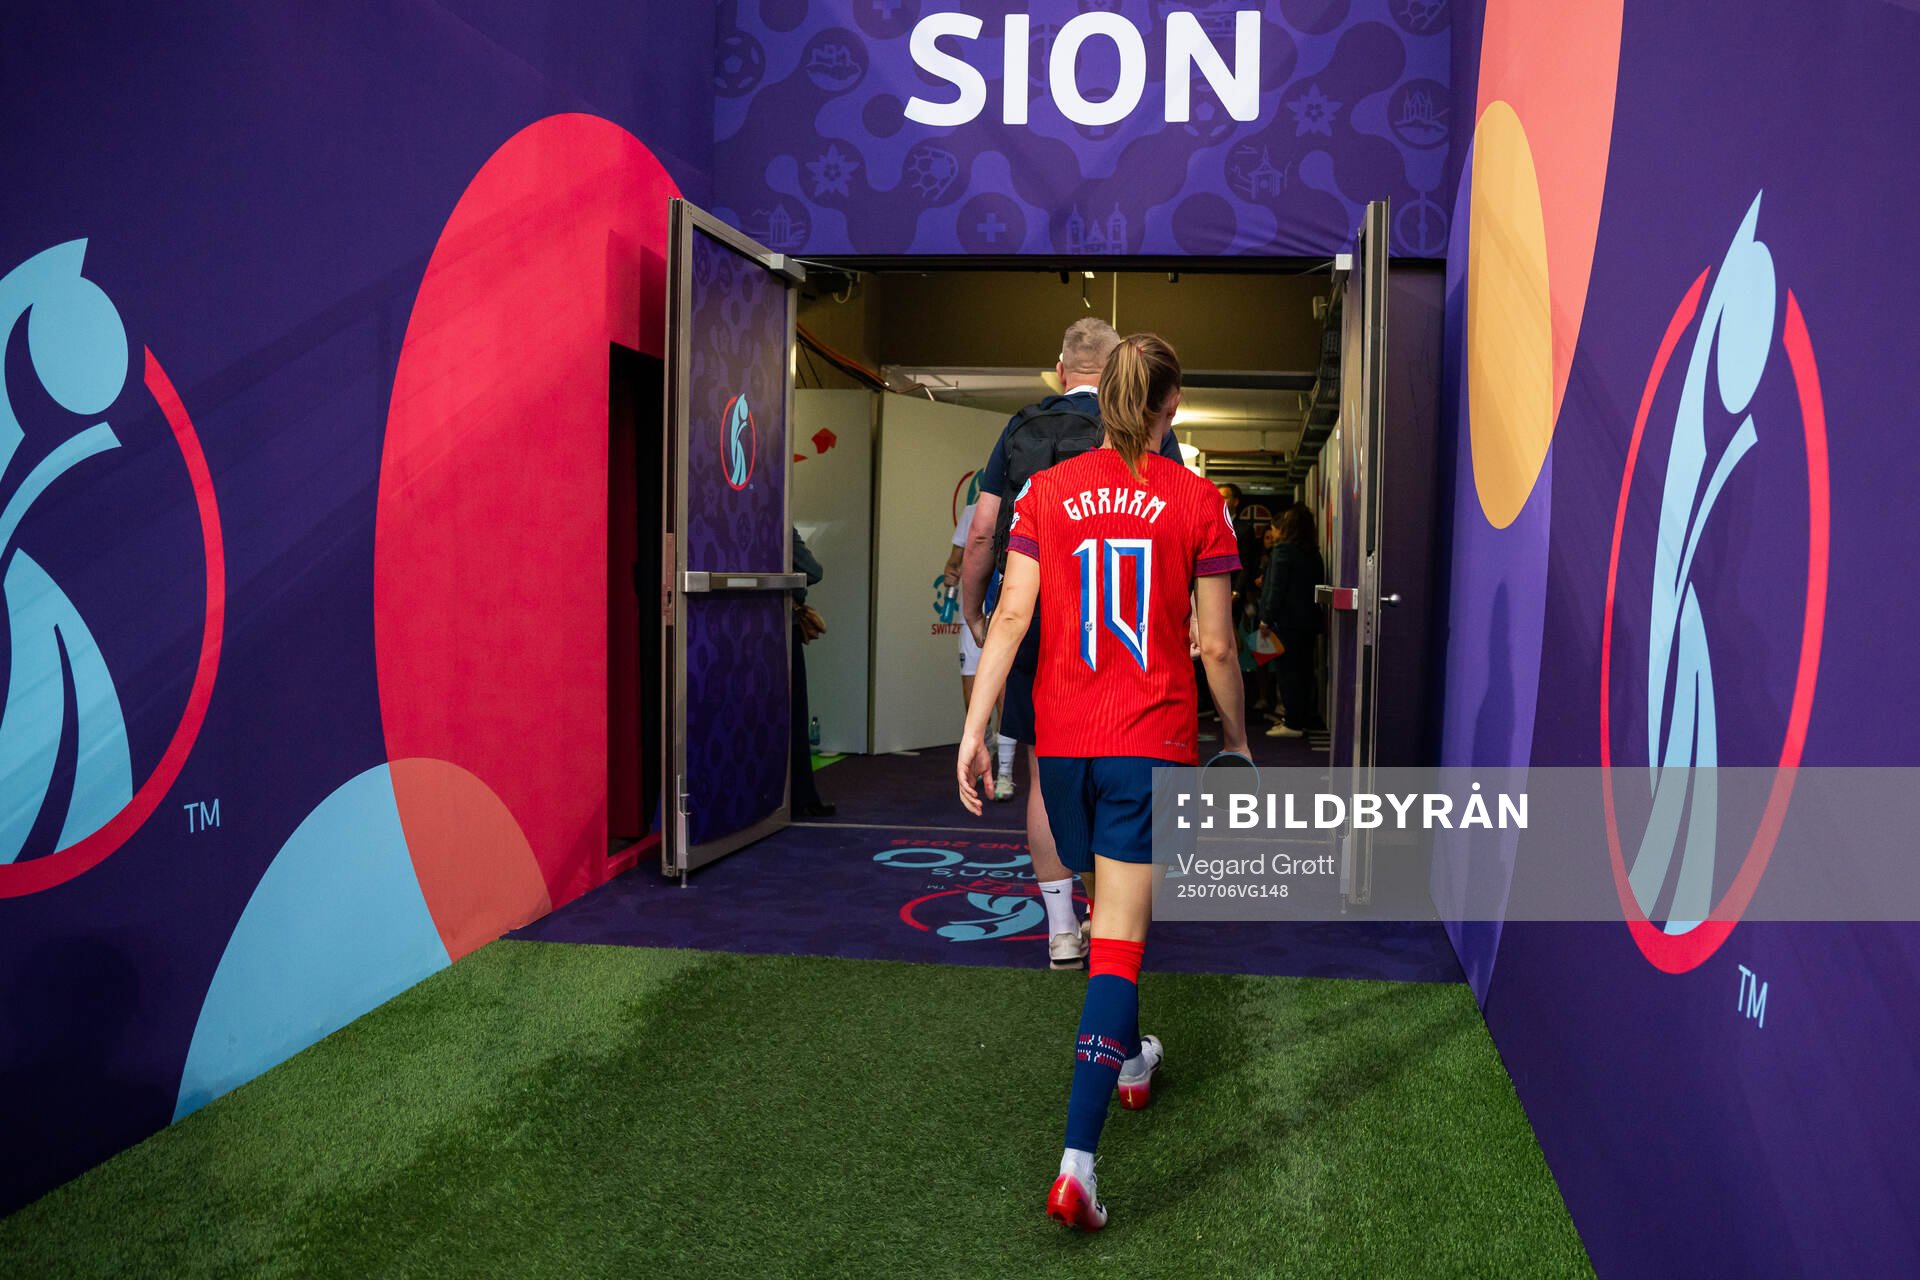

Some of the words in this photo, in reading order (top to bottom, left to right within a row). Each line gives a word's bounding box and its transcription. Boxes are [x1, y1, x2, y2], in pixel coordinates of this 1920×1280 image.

[904, 10, 1261, 127] SION
[1063, 487, 1167, 524] GRAHAM
[1072, 538, 1152, 673] 10
[183, 798, 220, 833] TM
[1738, 964, 1768, 1029] TM
